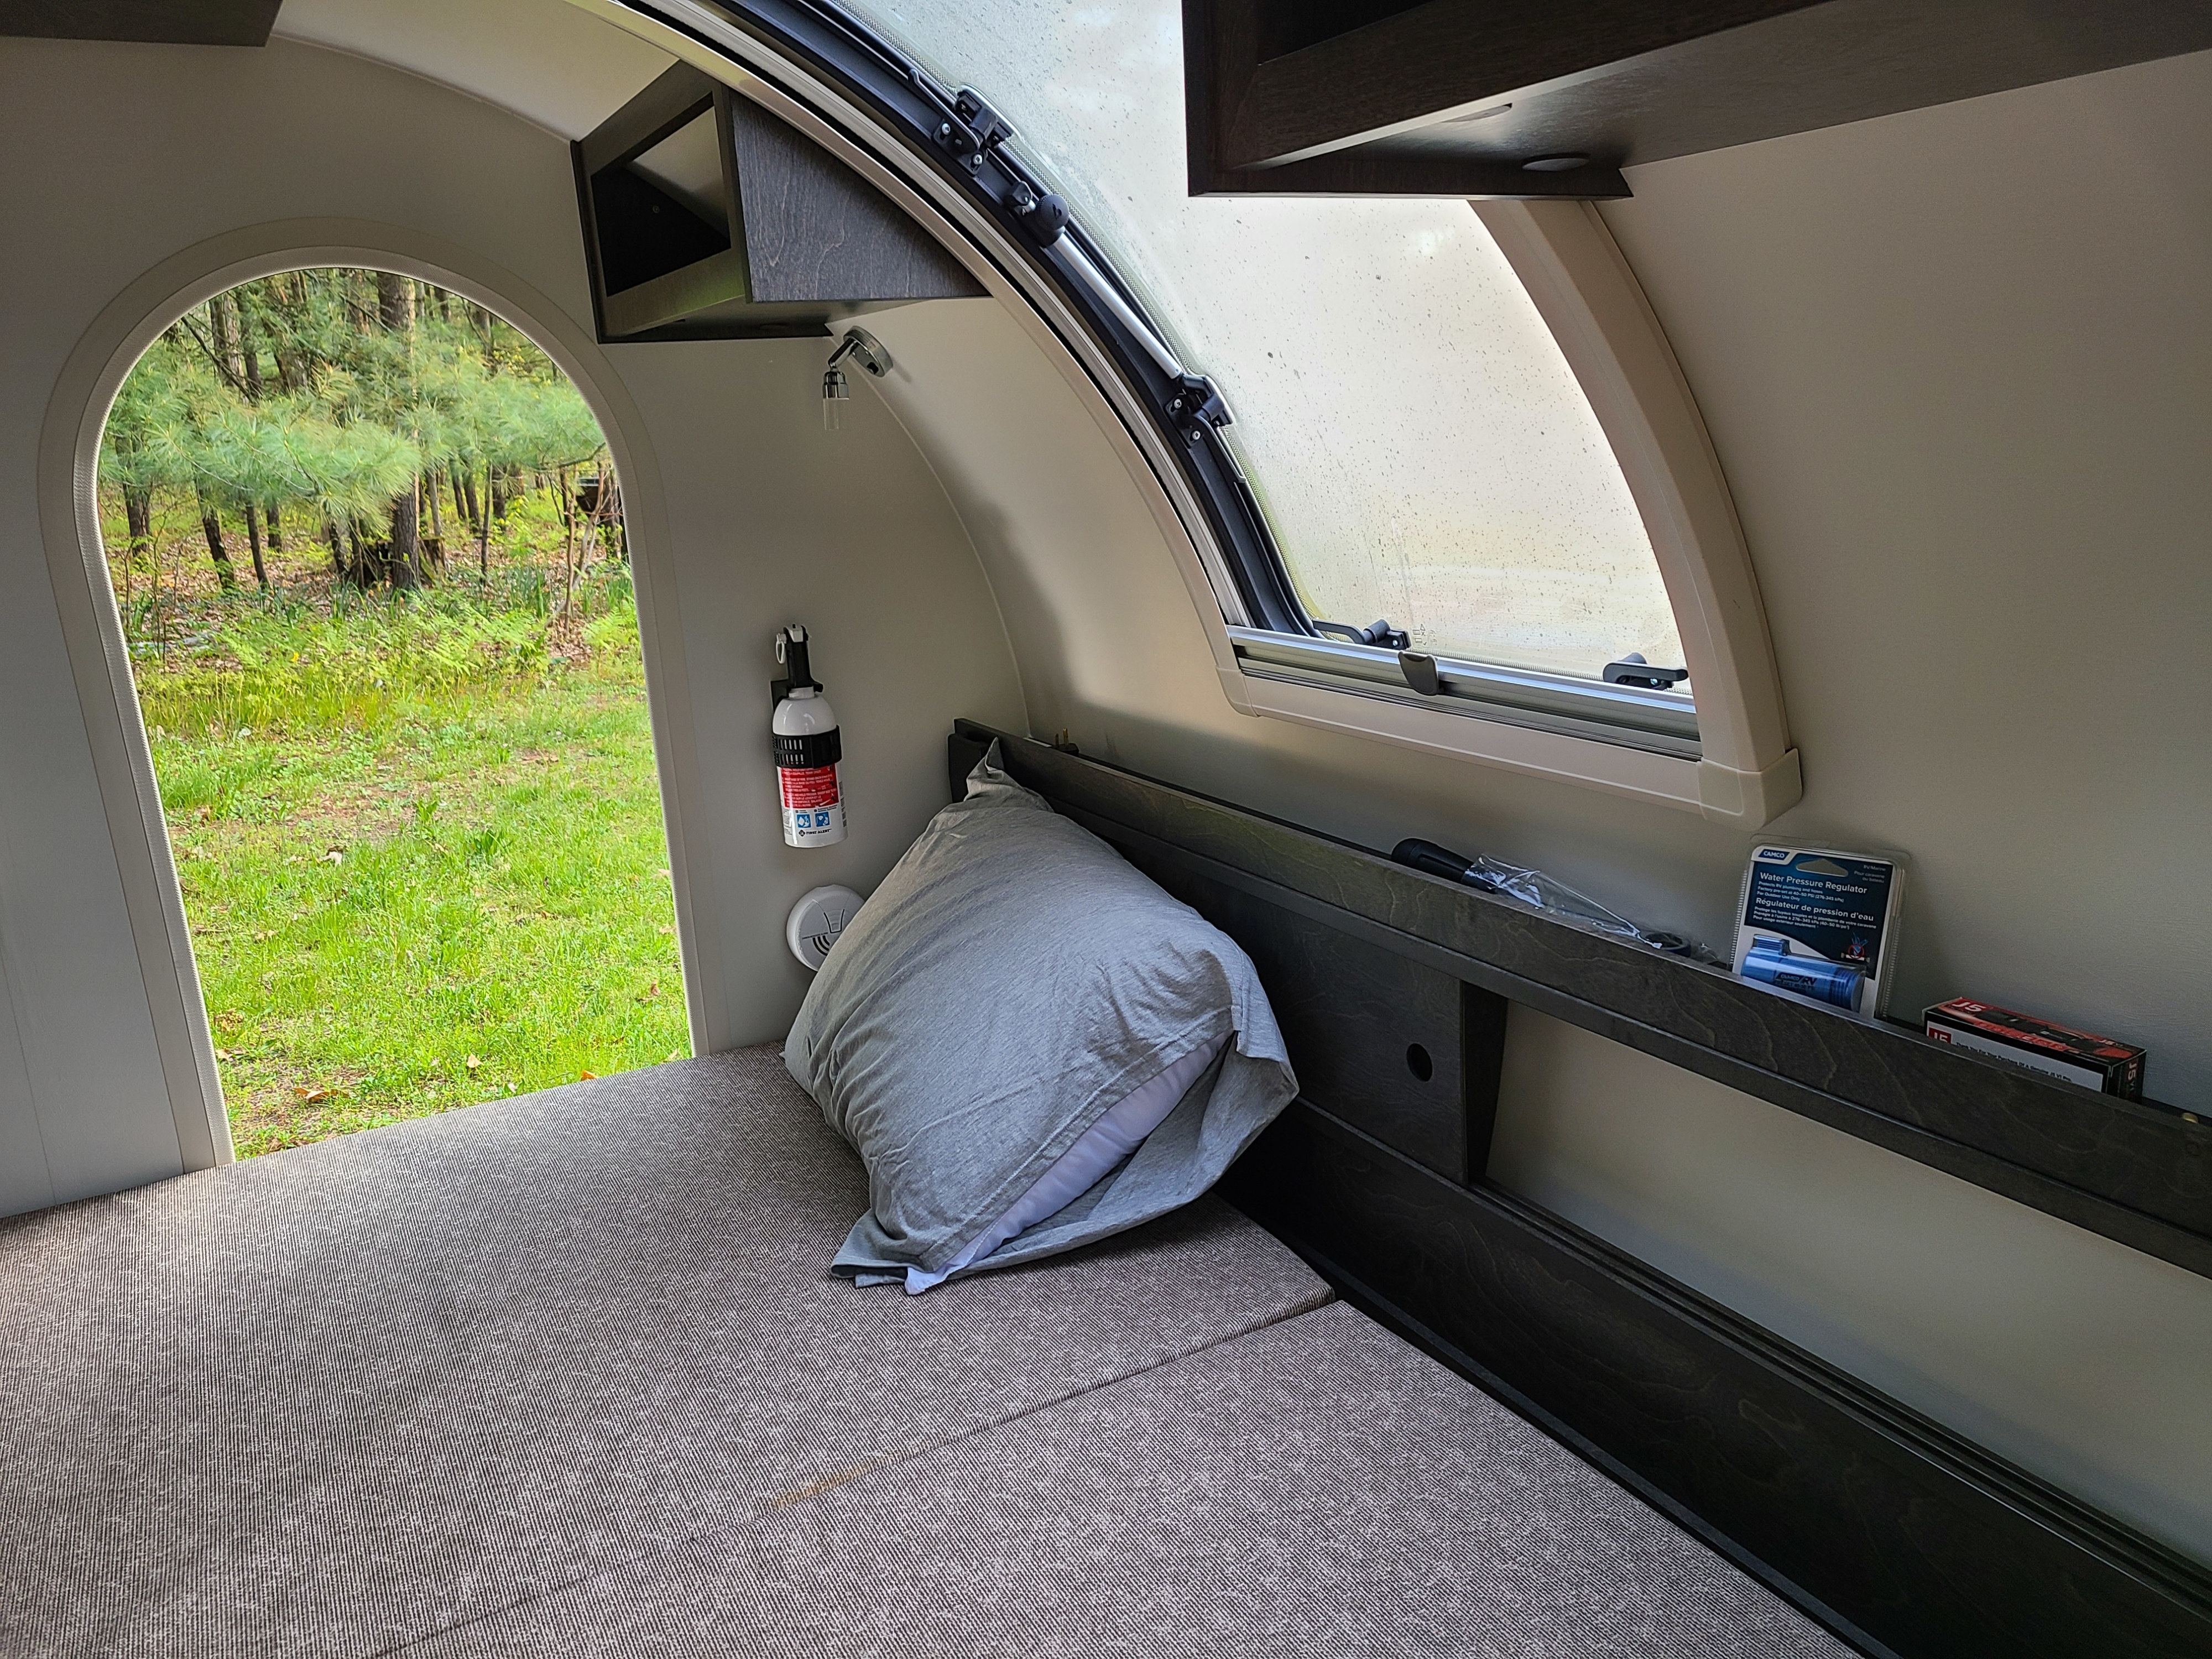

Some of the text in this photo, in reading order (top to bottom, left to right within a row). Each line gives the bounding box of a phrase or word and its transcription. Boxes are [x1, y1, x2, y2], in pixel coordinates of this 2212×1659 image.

[1760, 872, 1867, 894] Water Pressure Regulator
[1756, 897, 1800, 910] Régulateur
[1813, 907, 1849, 918] pression
[1951, 1001, 1986, 1012] J5
[2128, 1061, 2137, 1081] J5
